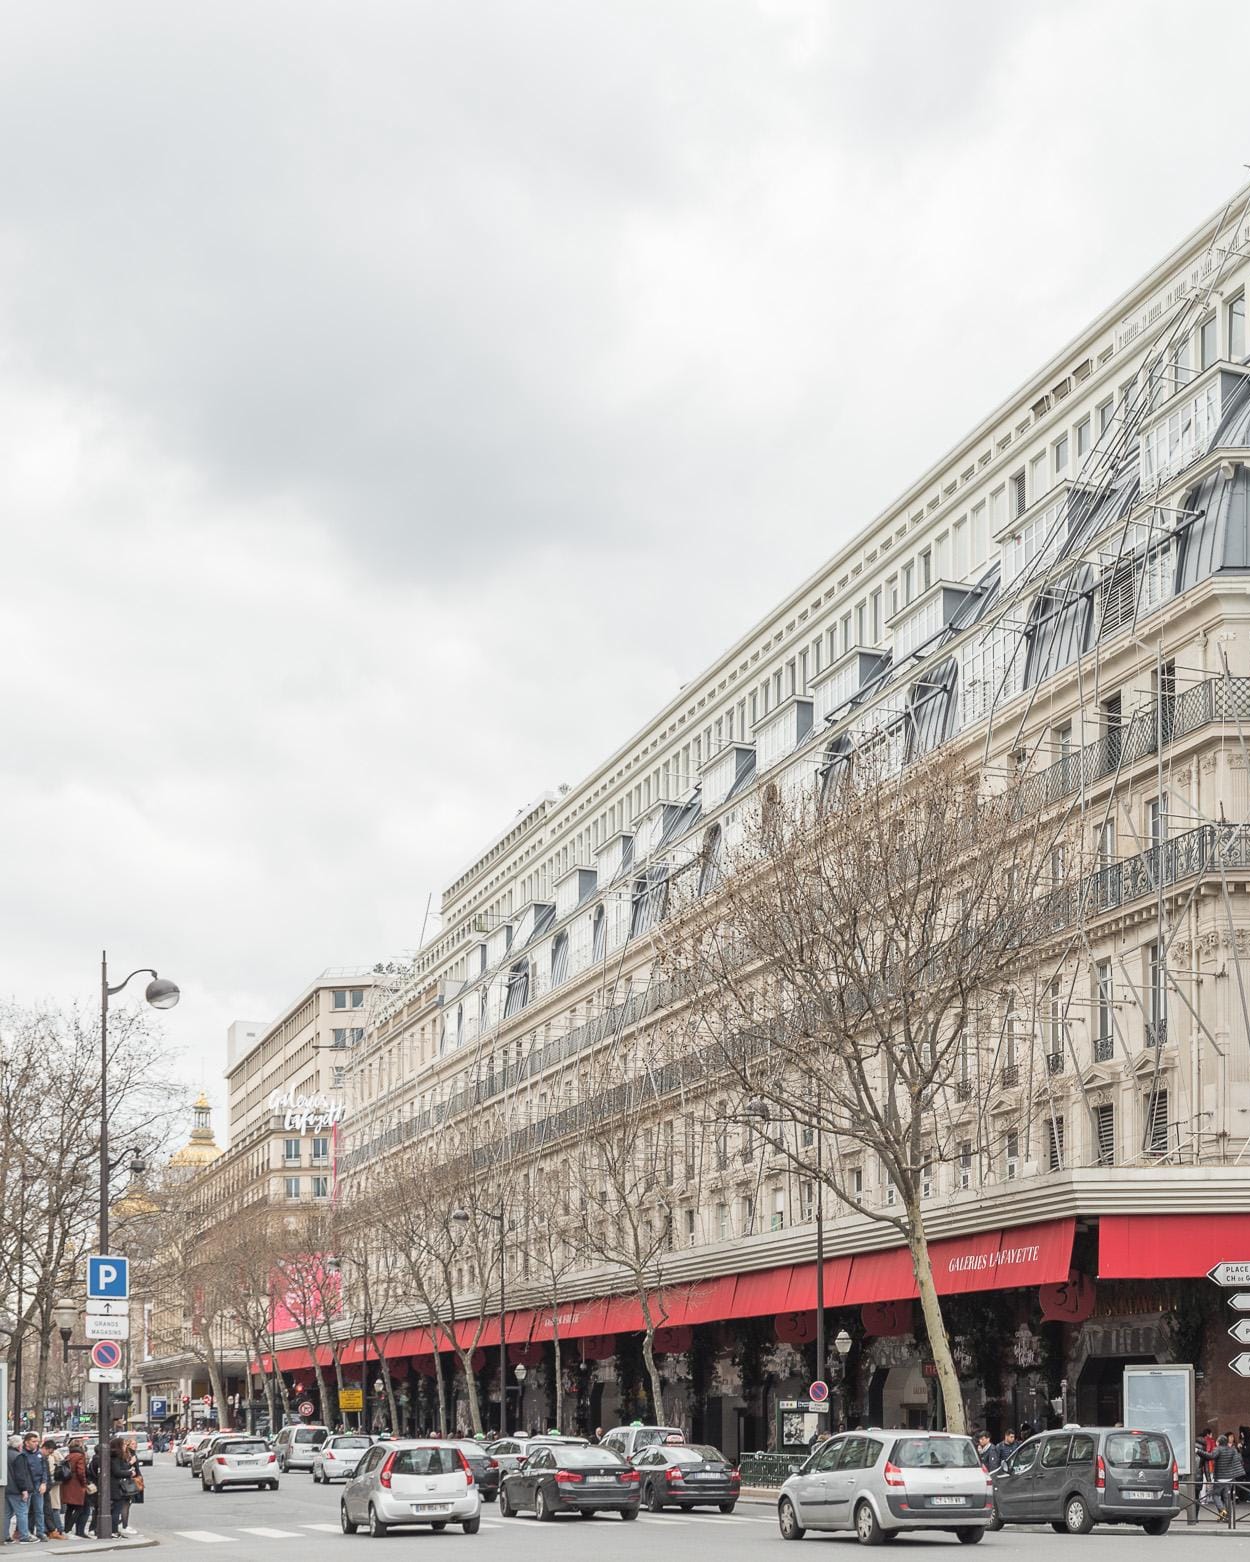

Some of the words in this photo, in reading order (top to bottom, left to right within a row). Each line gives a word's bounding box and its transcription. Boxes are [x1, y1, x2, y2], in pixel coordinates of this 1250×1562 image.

[948, 1254, 988, 1272] GALERIES
[989, 1245, 1040, 1268] LAFAYETTE
[99, 1264, 117, 1290] P
